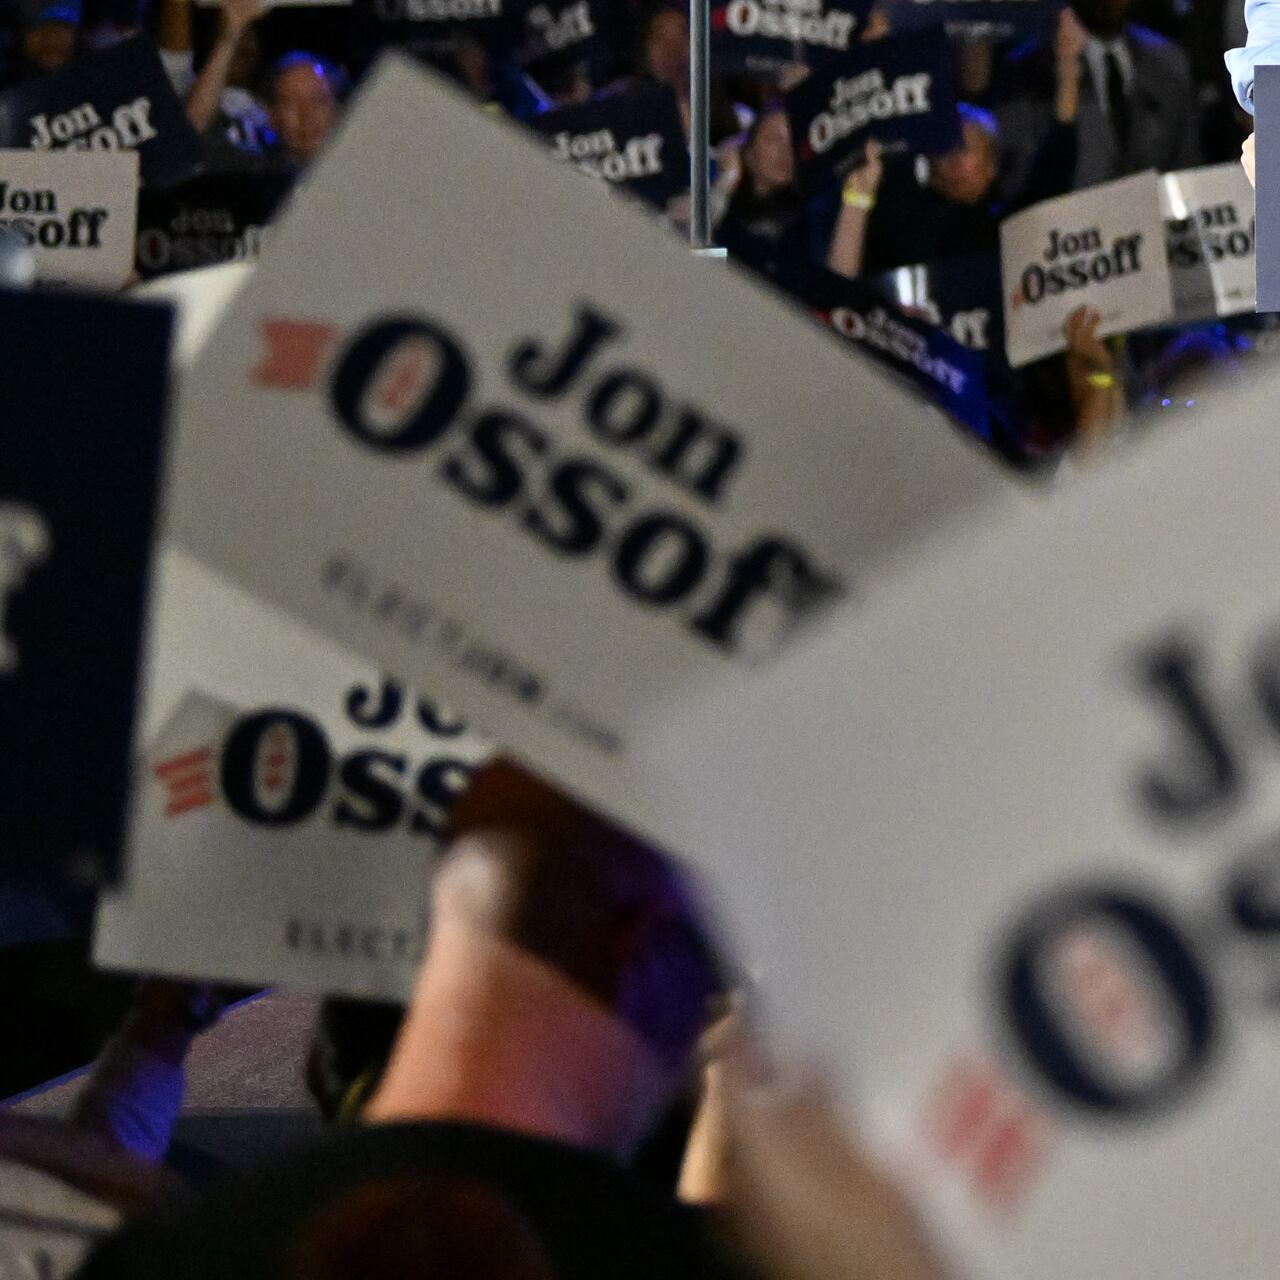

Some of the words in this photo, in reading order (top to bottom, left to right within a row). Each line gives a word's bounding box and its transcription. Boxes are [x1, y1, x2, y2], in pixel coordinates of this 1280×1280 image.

[28, 102, 100, 151] Jon
[1020, 230, 1145, 304] Ossoff
[1042, 225, 1103, 262] Jon
[510, 305, 745, 505] Jon
